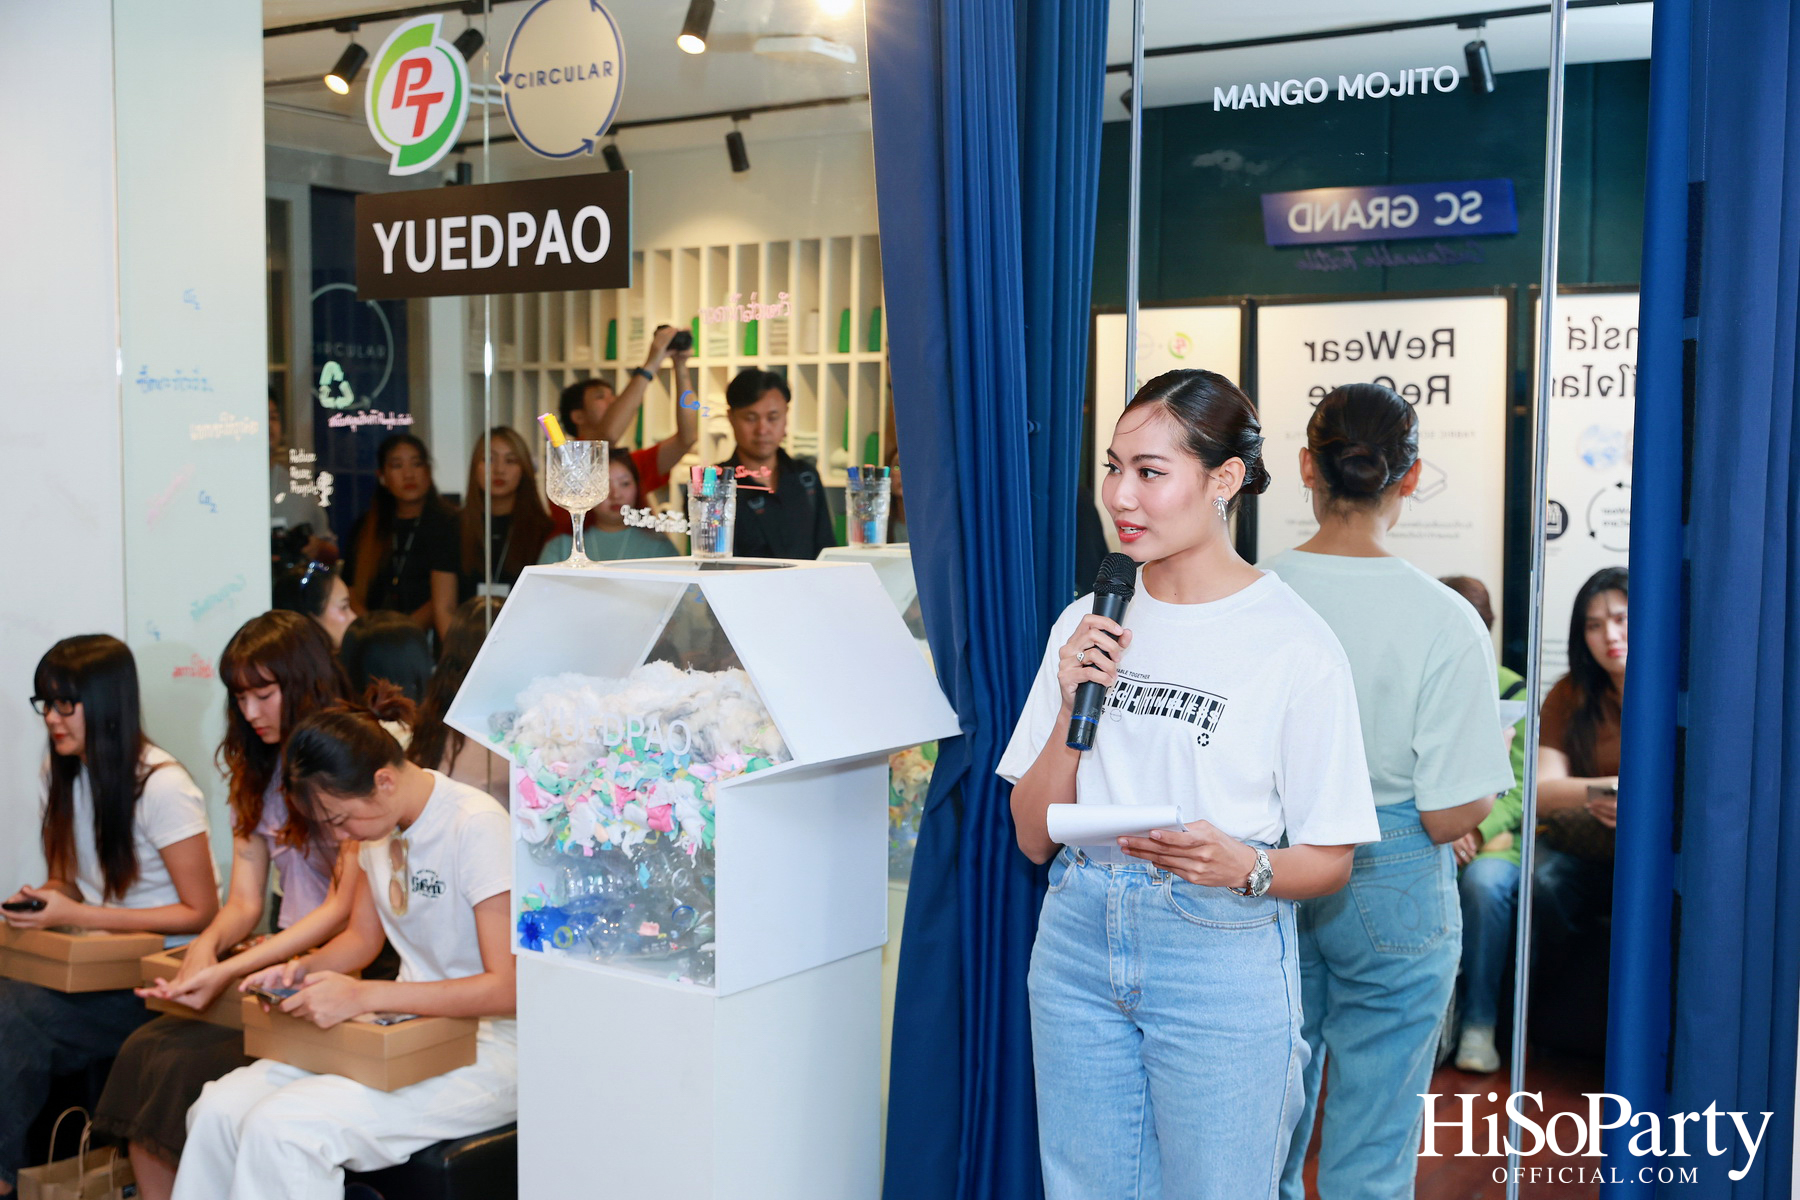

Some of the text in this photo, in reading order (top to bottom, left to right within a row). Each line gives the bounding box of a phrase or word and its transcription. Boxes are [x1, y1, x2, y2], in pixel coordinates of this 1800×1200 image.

[514, 60, 614, 89] CIRCULAR
[1213, 65, 1460, 112] MANGO MOJITO
[372, 205, 611, 274] YUEDPAO
[542, 705, 692, 756] YUEDPAO
